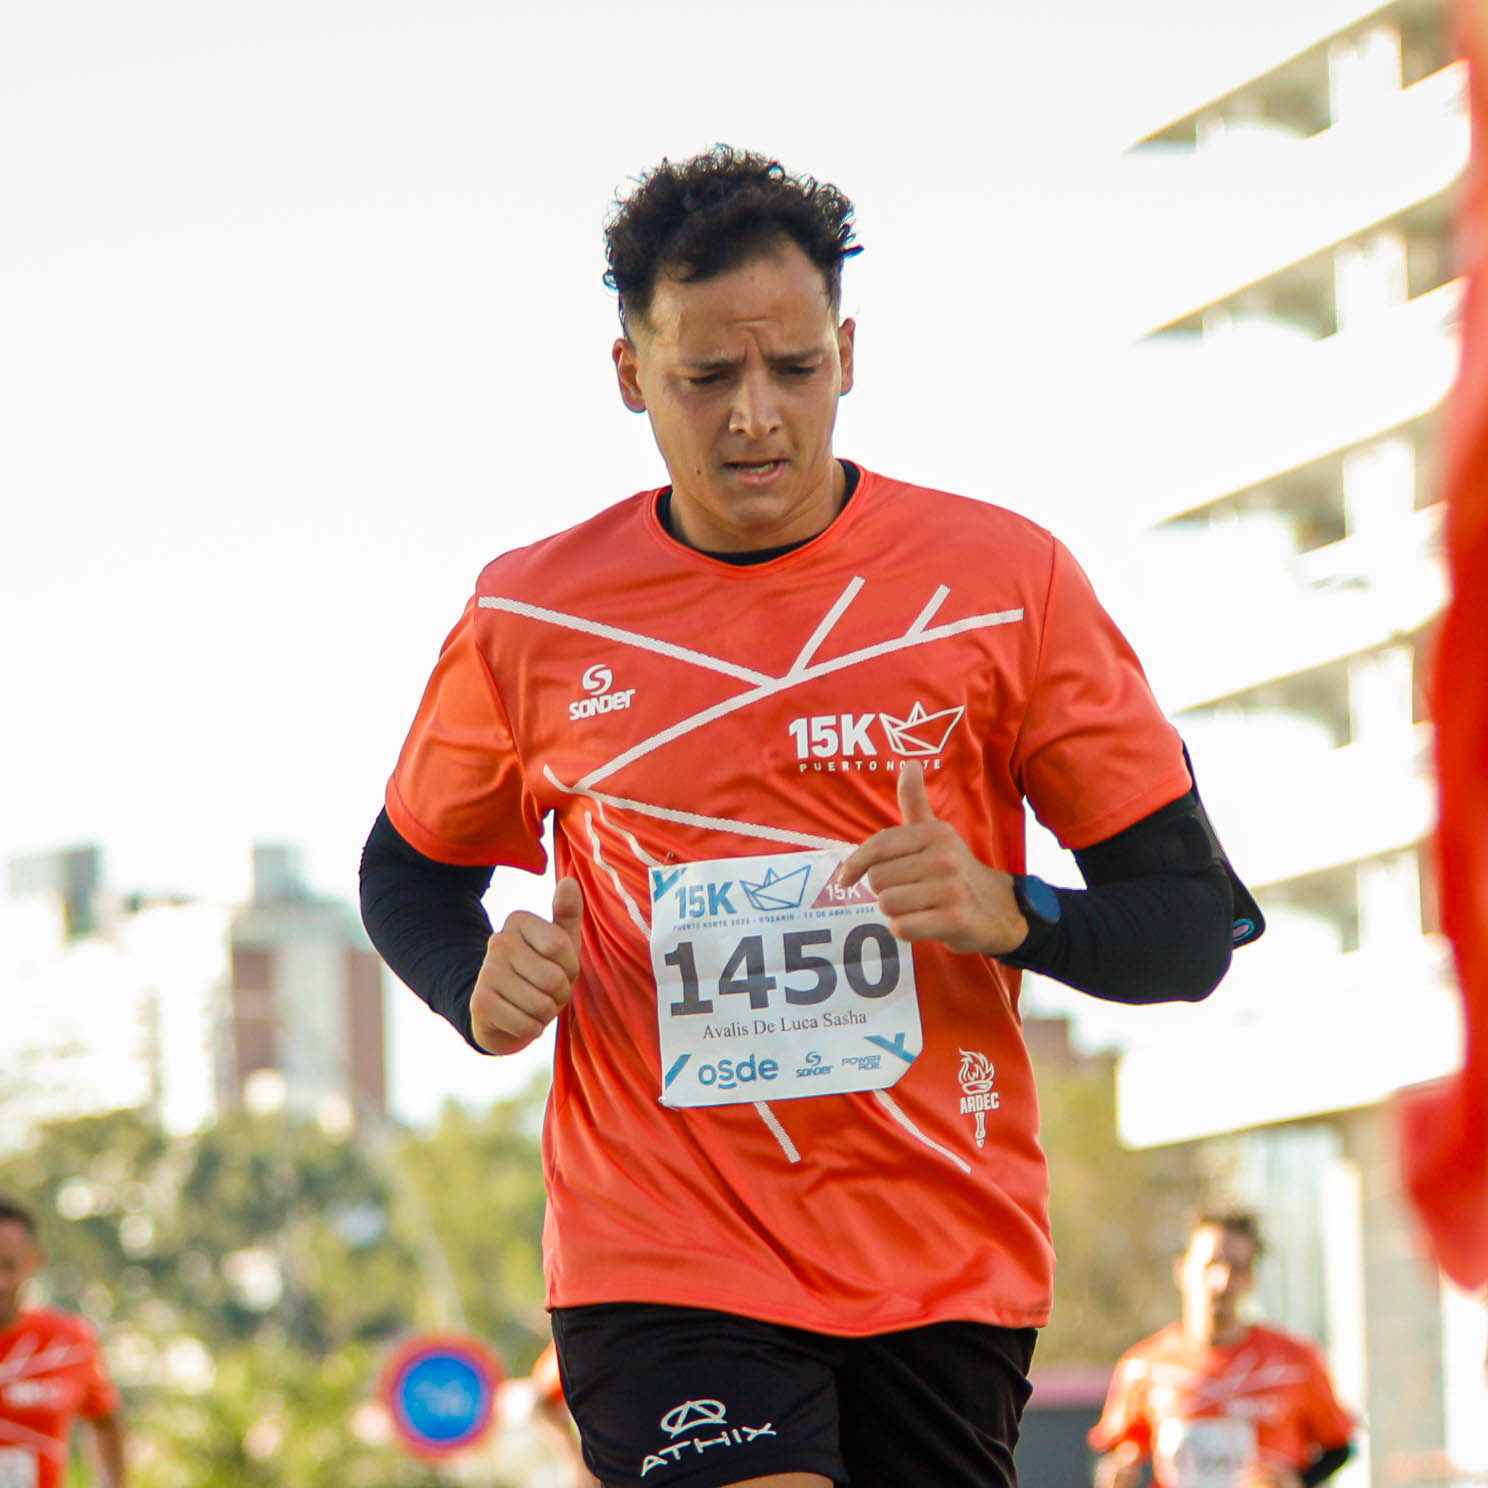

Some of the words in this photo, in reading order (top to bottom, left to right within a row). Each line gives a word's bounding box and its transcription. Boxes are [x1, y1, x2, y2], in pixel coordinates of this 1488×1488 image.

[788, 713, 878, 759] 15K
[799, 760, 878, 773] PUERTO
[886, 759, 943, 771] NOTE
[674, 880, 737, 919] 15K
[664, 922, 900, 1017] 1450
[703, 1022, 749, 1039] Avalis
[753, 1020, 776, 1034] De
[780, 1017, 818, 1032] Luca
[823, 1010, 867, 1027] Sasha
[698, 1052, 779, 1088] osde
[960, 1092, 1000, 1114] ARDEC
[640, 1422, 777, 1478] ATHIX
